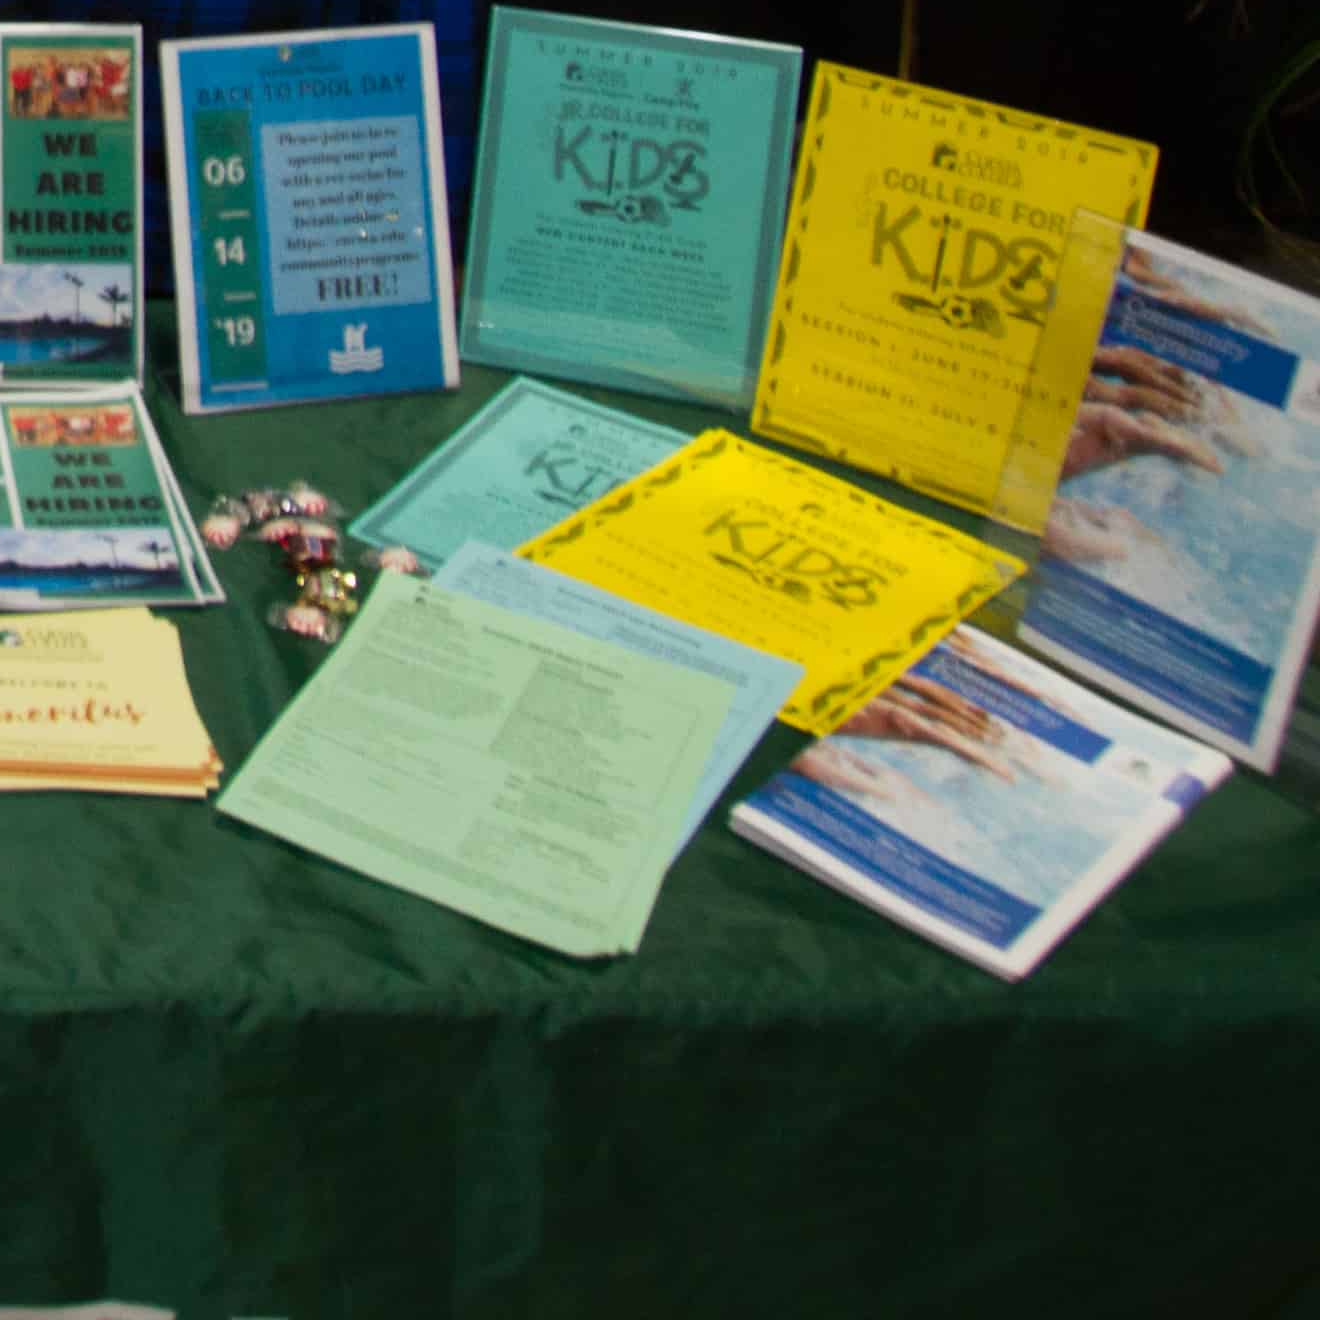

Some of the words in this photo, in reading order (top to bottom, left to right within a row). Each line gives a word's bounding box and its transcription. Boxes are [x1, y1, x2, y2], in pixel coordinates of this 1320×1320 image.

[43, 132, 98, 158] WE
[35, 171, 106, 196] ARE
[202, 155, 246, 186] 06
[882, 166, 1003, 217] COLLEGE
[1010, 201, 1067, 235] FOR
[8, 209, 133, 234] HIRING
[213, 236, 246, 266] 14
